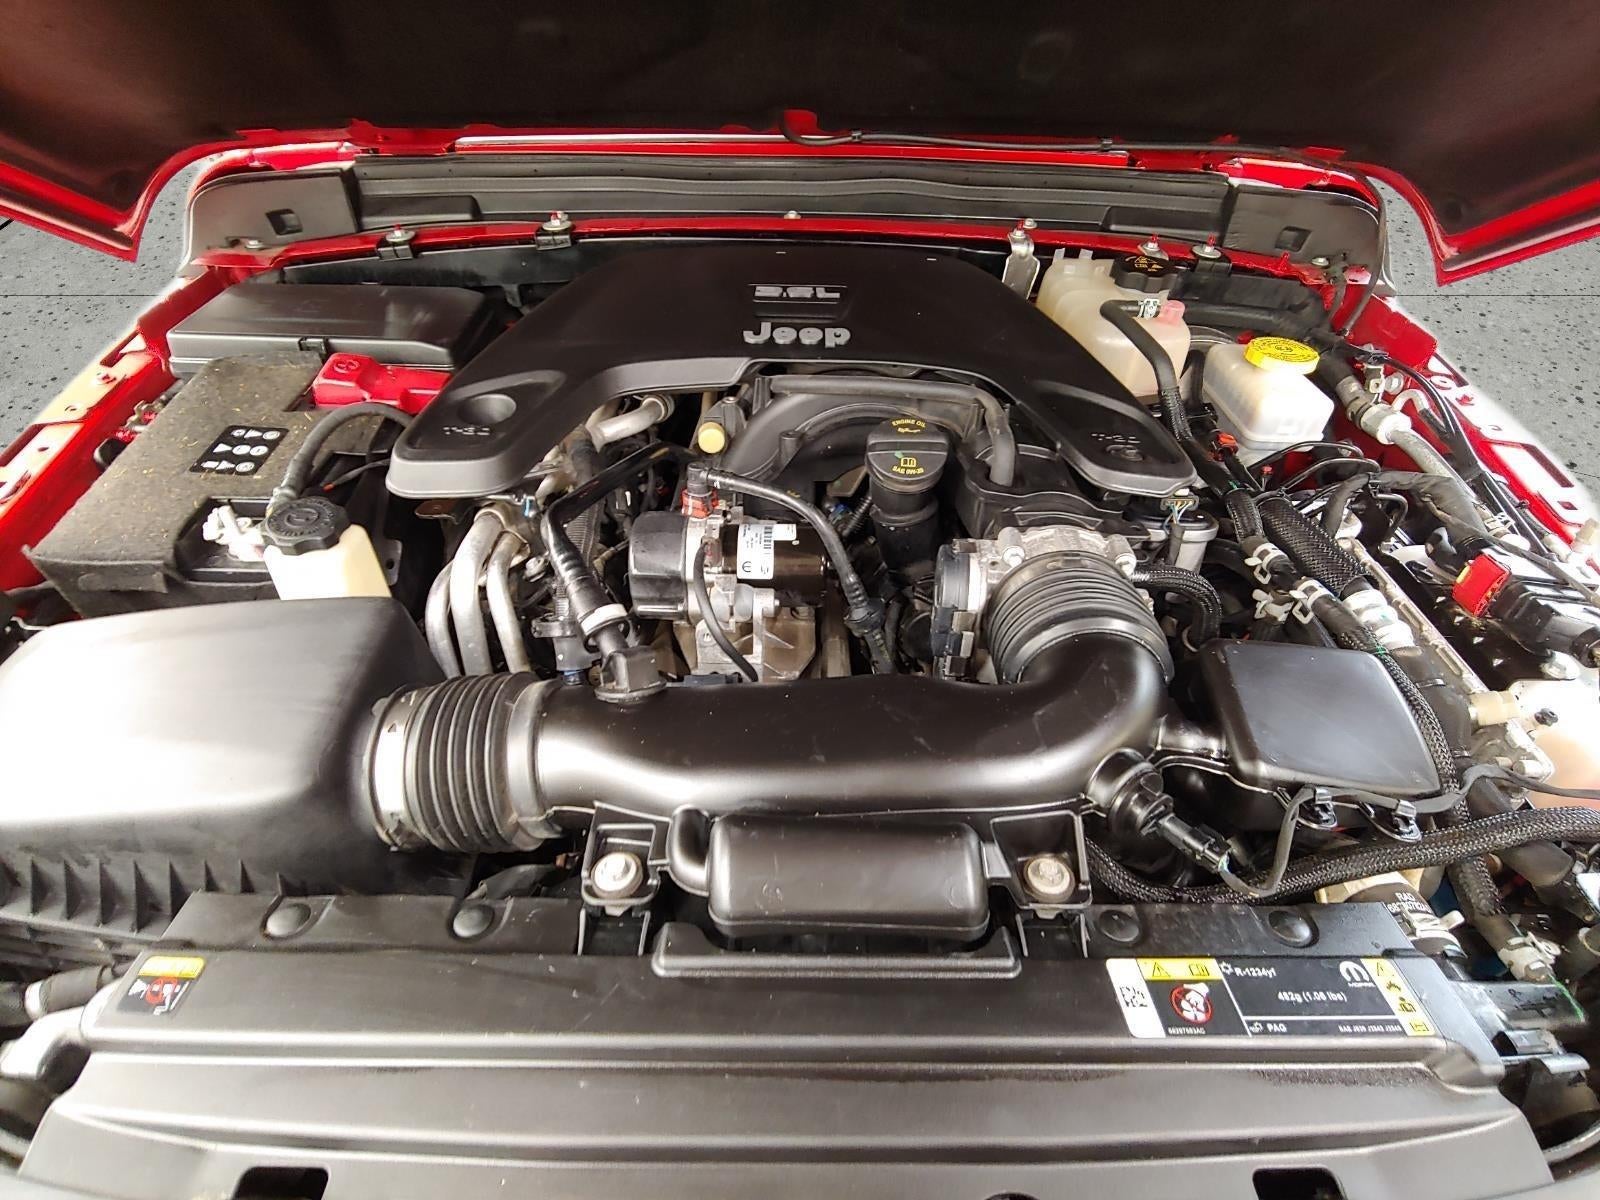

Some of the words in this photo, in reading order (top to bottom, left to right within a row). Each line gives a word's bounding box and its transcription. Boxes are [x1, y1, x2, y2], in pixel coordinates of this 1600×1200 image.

[743, 321, 851, 349] Jeep
[892, 419, 916, 427] ENGINE
[916, 420, 927, 428] OIL
[892, 465, 906, 474] SAE
[1395, 892, 1416, 902] RAD
